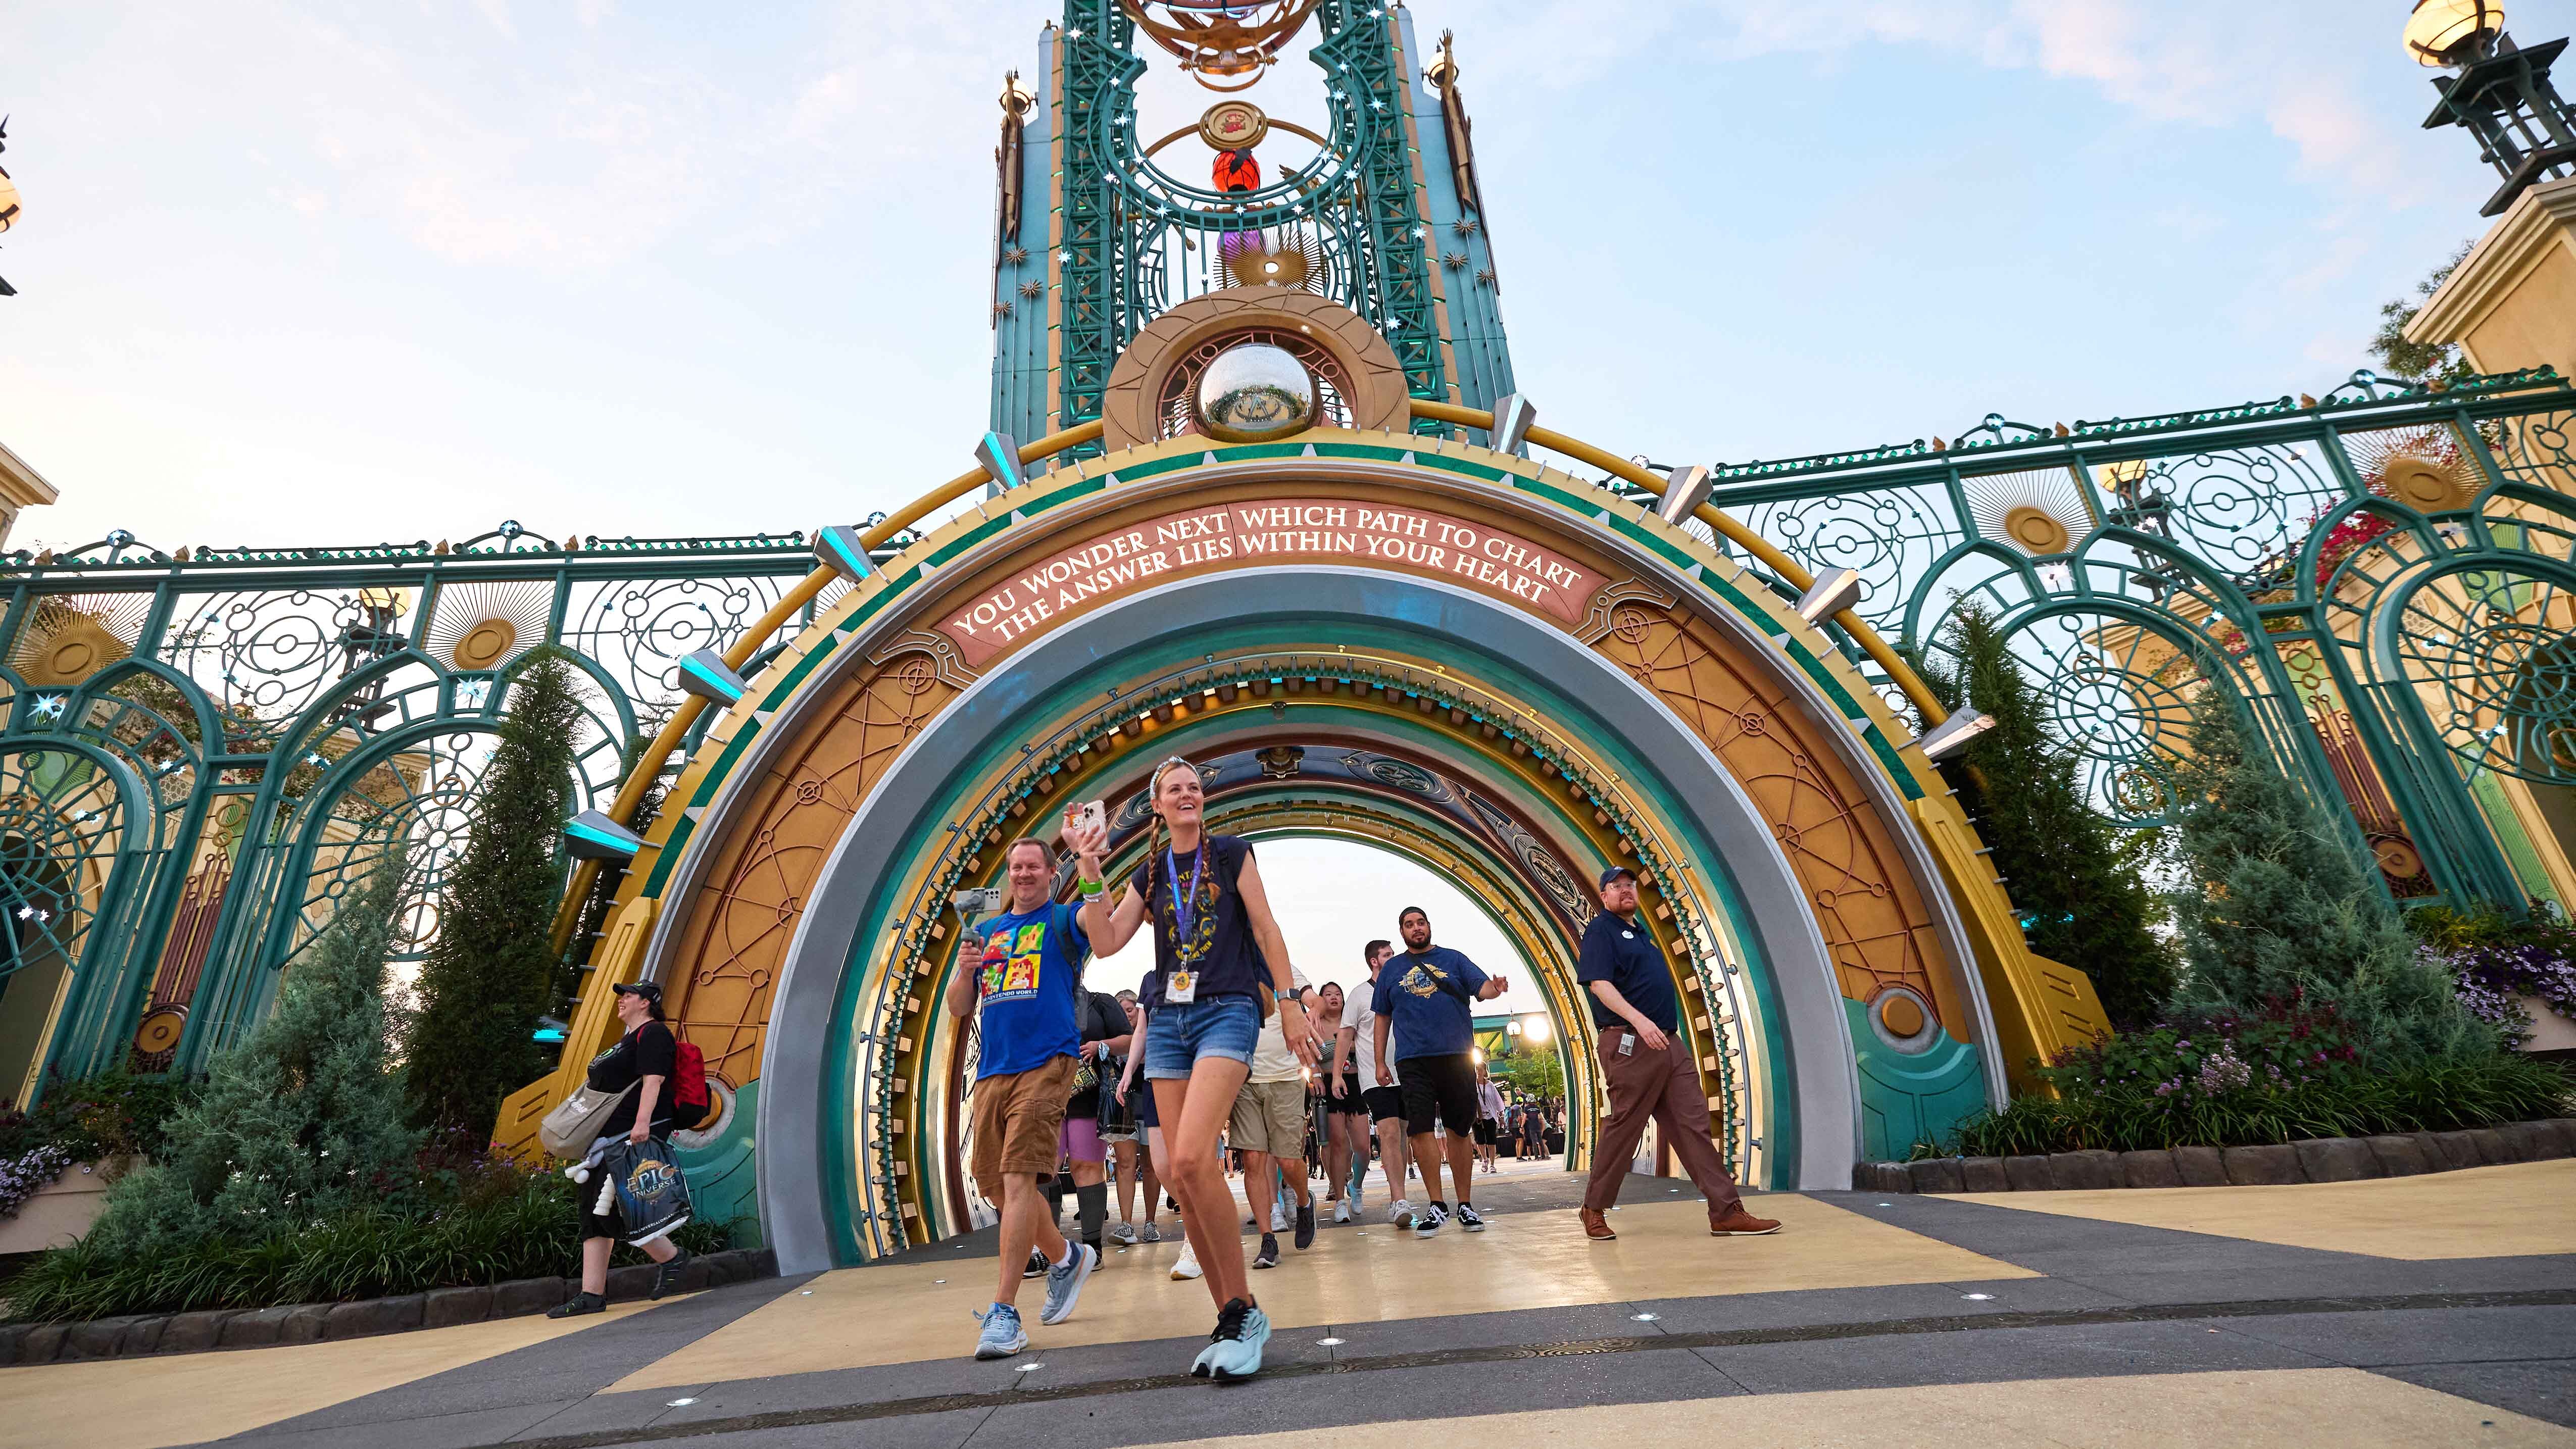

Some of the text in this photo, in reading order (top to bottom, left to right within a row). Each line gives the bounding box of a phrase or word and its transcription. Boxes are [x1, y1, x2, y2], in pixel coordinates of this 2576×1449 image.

[954, 506, 1582, 636] YOU WONDER NEXT WHICH PATH TO CHART
[993, 532, 1551, 642] THE ANSWER LIES WITHIN YOUR HEART
[987, 991, 1015, 1000] NINTENDO
[626, 1164, 675, 1192] EPIC
